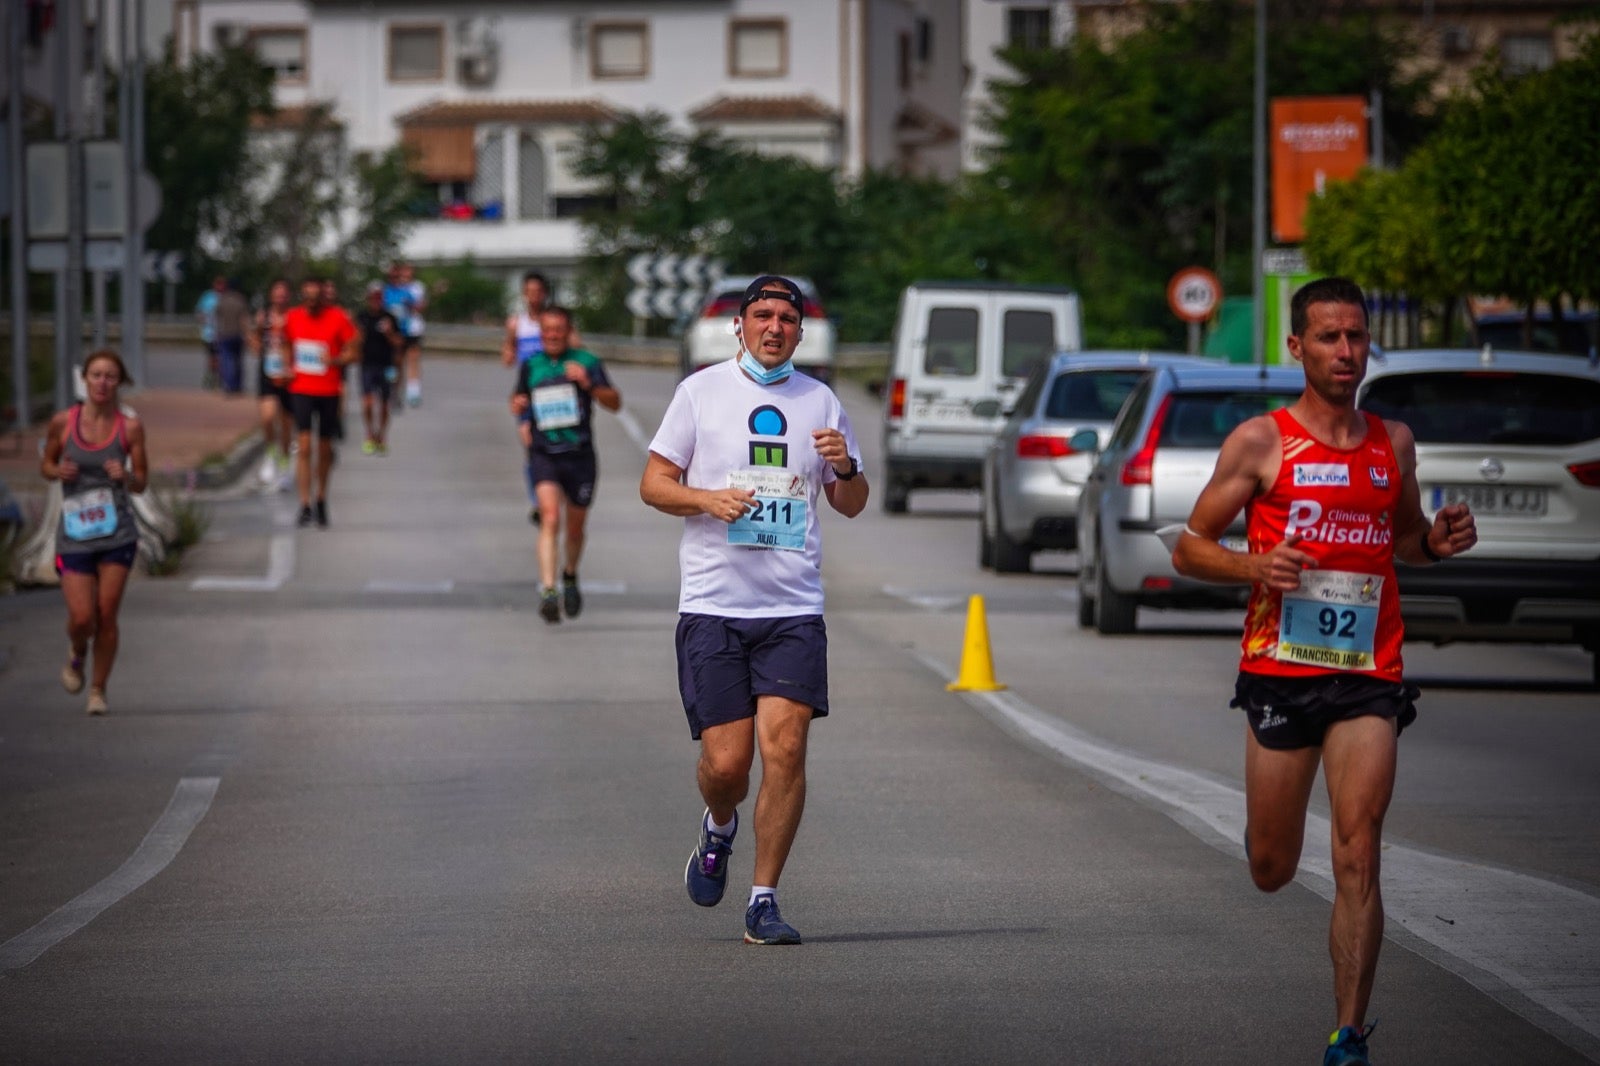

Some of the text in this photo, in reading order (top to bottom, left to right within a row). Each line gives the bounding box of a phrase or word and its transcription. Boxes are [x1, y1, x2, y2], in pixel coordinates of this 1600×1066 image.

[750, 500, 791, 525] 211
[1318, 607, 1357, 639] 92
[1290, 646, 1340, 665] FRANCISCO
